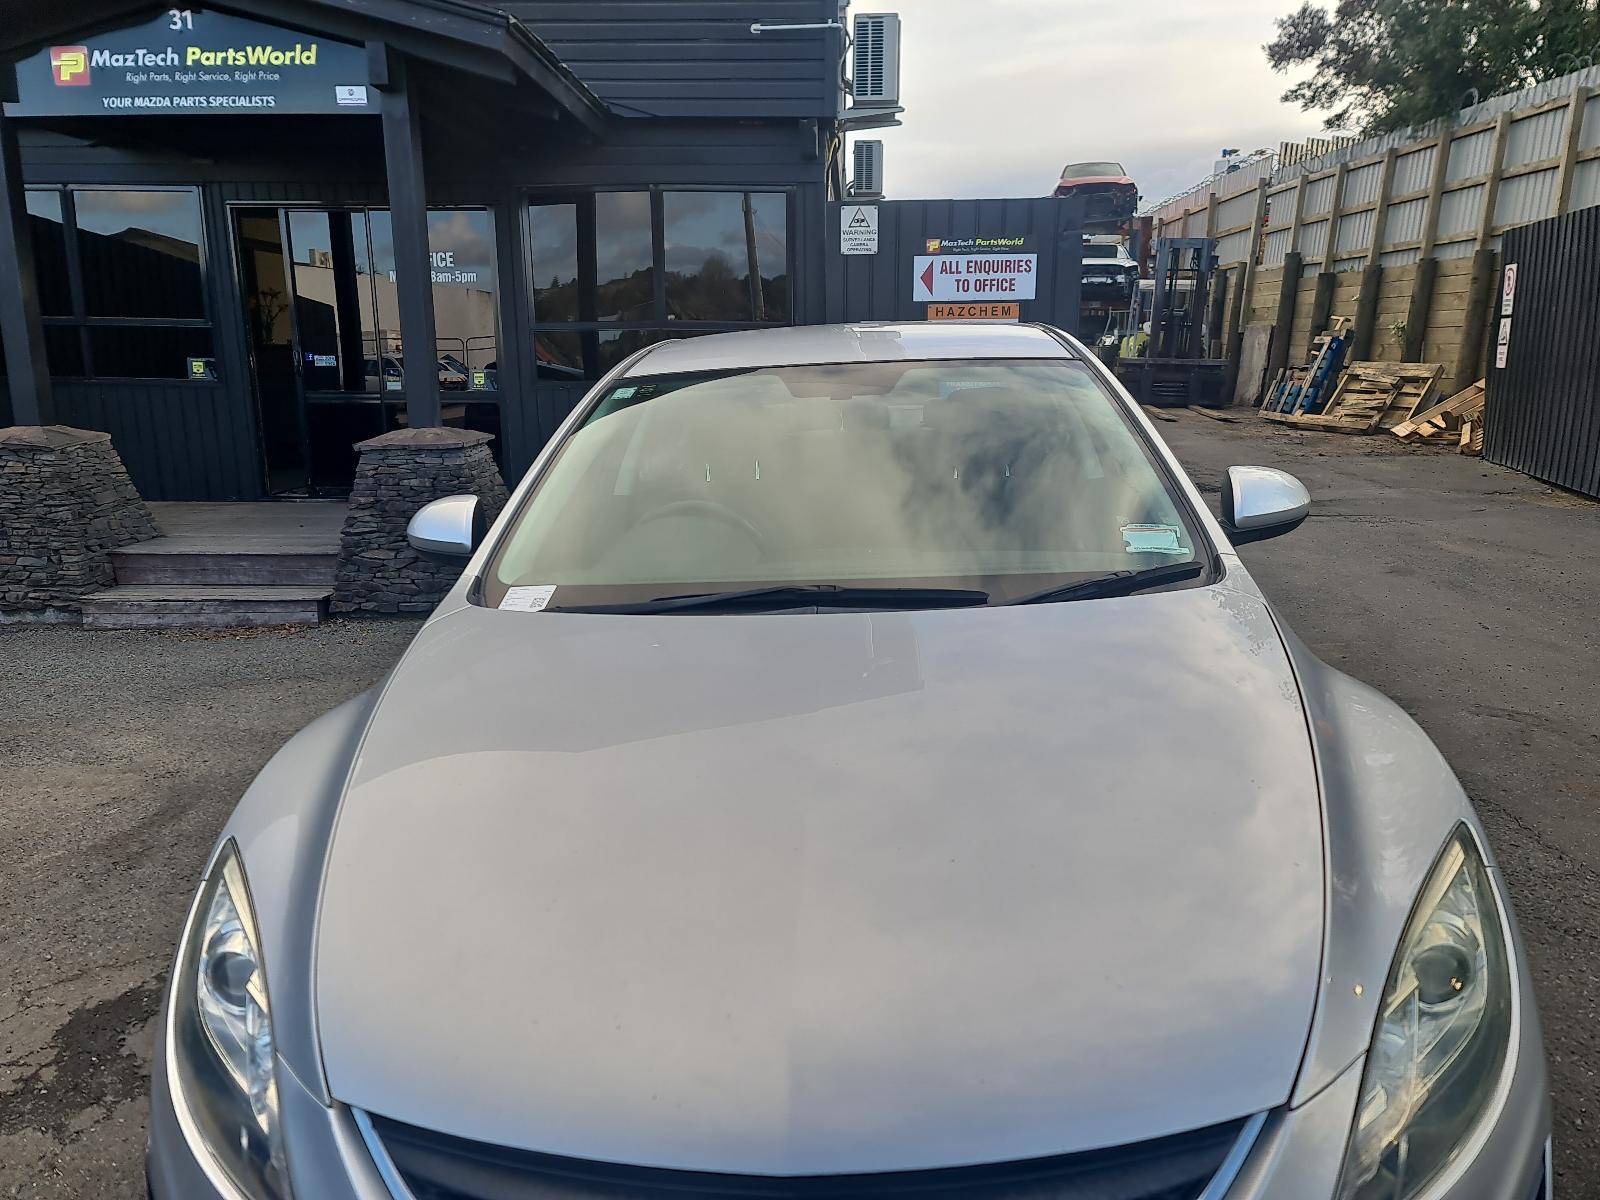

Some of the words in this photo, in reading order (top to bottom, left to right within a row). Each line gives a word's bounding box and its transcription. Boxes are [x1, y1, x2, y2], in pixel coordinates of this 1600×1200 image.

[168, 9, 193, 31] 31
[90, 47, 179, 67] MazTech
[186, 43, 318, 67] PartsWorld
[126, 71, 147, 84] Right
[149, 71, 172, 82] Parts,
[174, 71, 196, 84] Right
[198, 71, 232, 82] Service,
[234, 70, 256, 83] Right
[258, 71, 280, 81] Price
[102, 97, 134, 108] YOUR
[134, 97, 171, 107] MAZDA
[173, 97, 208, 107] PARTS
[209, 96, 276, 107] SPECIALISTS
[941, 239, 974, 247] MazTech
[976, 237, 1025, 246] PartsWorld
[939, 260, 962, 275] ALL
[966, 259, 1033, 275] ENQUIRIES
[955, 279, 970, 293] TO
[974, 278, 1016, 292] OFFICE
[935, 305, 1012, 317] HAZCHEM
